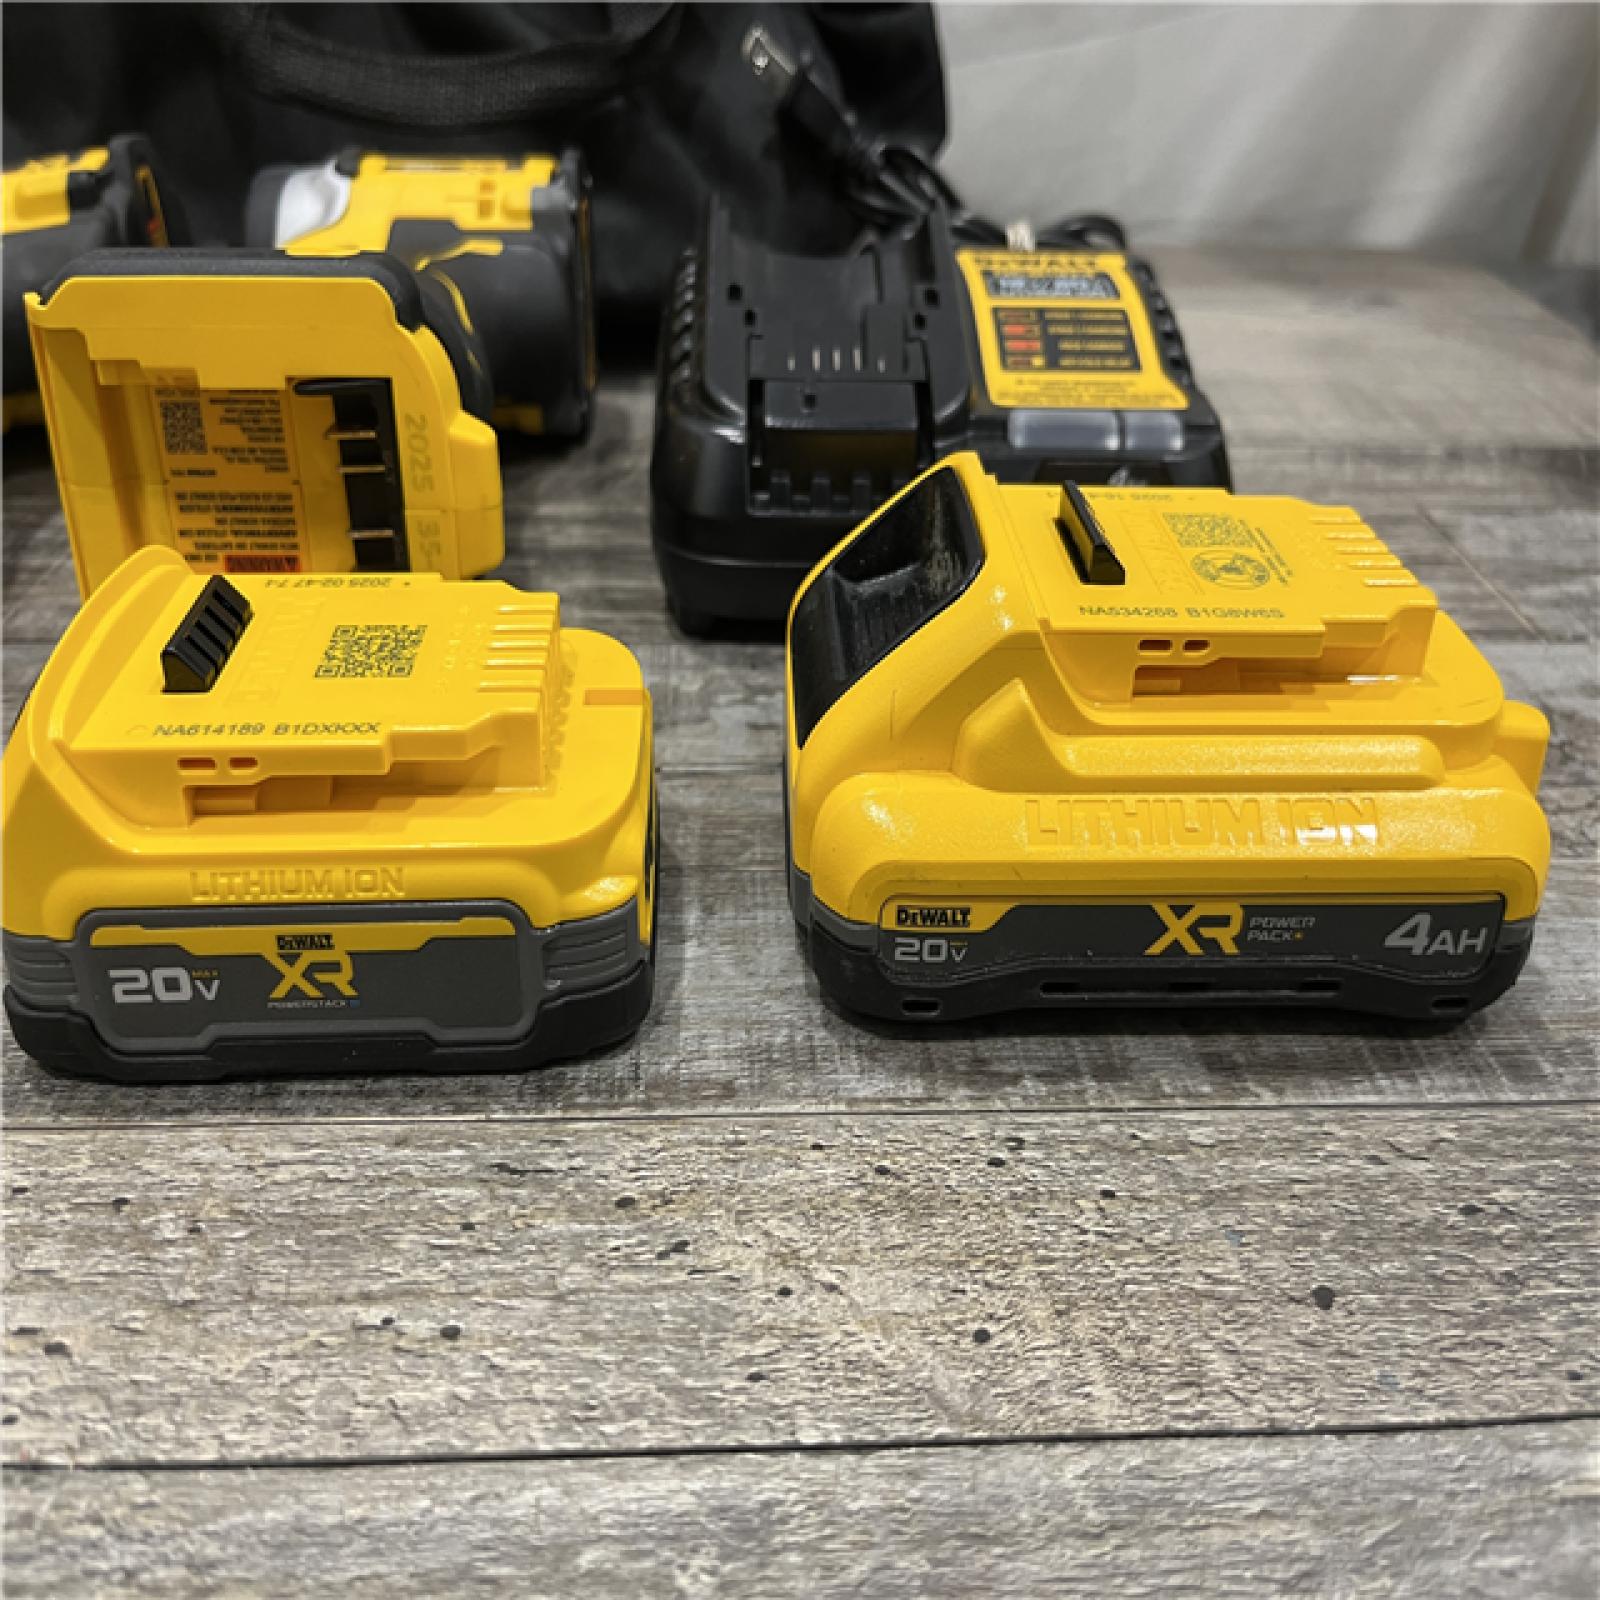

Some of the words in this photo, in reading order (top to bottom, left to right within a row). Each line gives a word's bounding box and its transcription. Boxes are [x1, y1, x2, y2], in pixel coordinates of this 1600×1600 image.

[405, 412, 435, 492] 2025
[151, 721, 266, 736] NA614189
[1025, 798, 1263, 846] LITHIUM
[1278, 797, 1379, 846] ION
[188, 869, 335, 902] LITHIUM
[344, 866, 406, 897] ION
[1143, 902, 1244, 956] XR
[1247, 929, 1294, 942] PACK
[1248, 916, 1316, 929] POWER
[262, 949, 360, 999] XR
